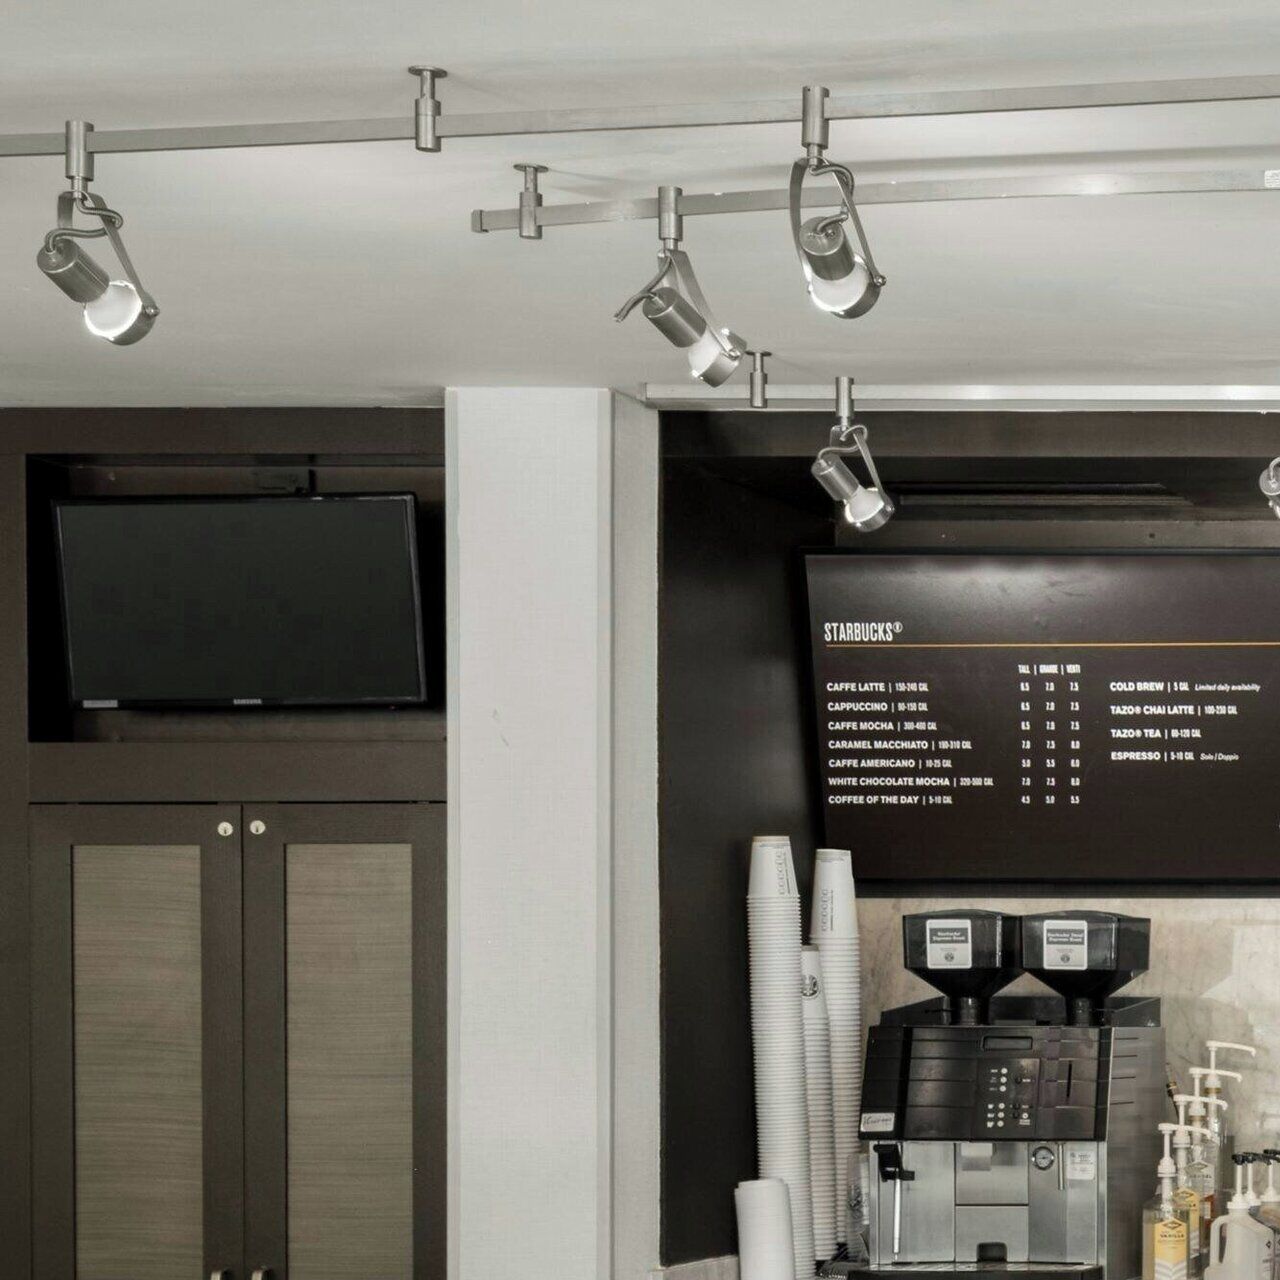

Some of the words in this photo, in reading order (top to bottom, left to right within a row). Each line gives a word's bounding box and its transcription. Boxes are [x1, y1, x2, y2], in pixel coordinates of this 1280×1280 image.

[825, 623, 902, 641] STARBUCKS®
[827, 683, 858, 691] CAFFE
[859, 683, 885, 691] LATTE
[1110, 682, 1136, 691] COLD
[1135, 682, 1164, 691] BREW
[828, 702, 888, 711] CAPPUCCINO
[1110, 706, 1142, 714] TAZO®
[1143, 706, 1166, 714] CHAI
[1166, 706, 1194, 714] LATTE
[828, 722, 859, 730] CAFFE
[860, 722, 894, 730] MOCHA
[1111, 729, 1143, 738] TAZO®
[1142, 729, 1161, 737] TEA
[829, 741, 873, 749] CARAMEL
[874, 741, 928, 749] MACCHIATO
[1111, 752, 1161, 760] ESPRESSO
[829, 759, 859, 767] CAFFE
[860, 759, 915, 767] AMERICANO
[860, 777, 915, 785] CHOCOLATE
